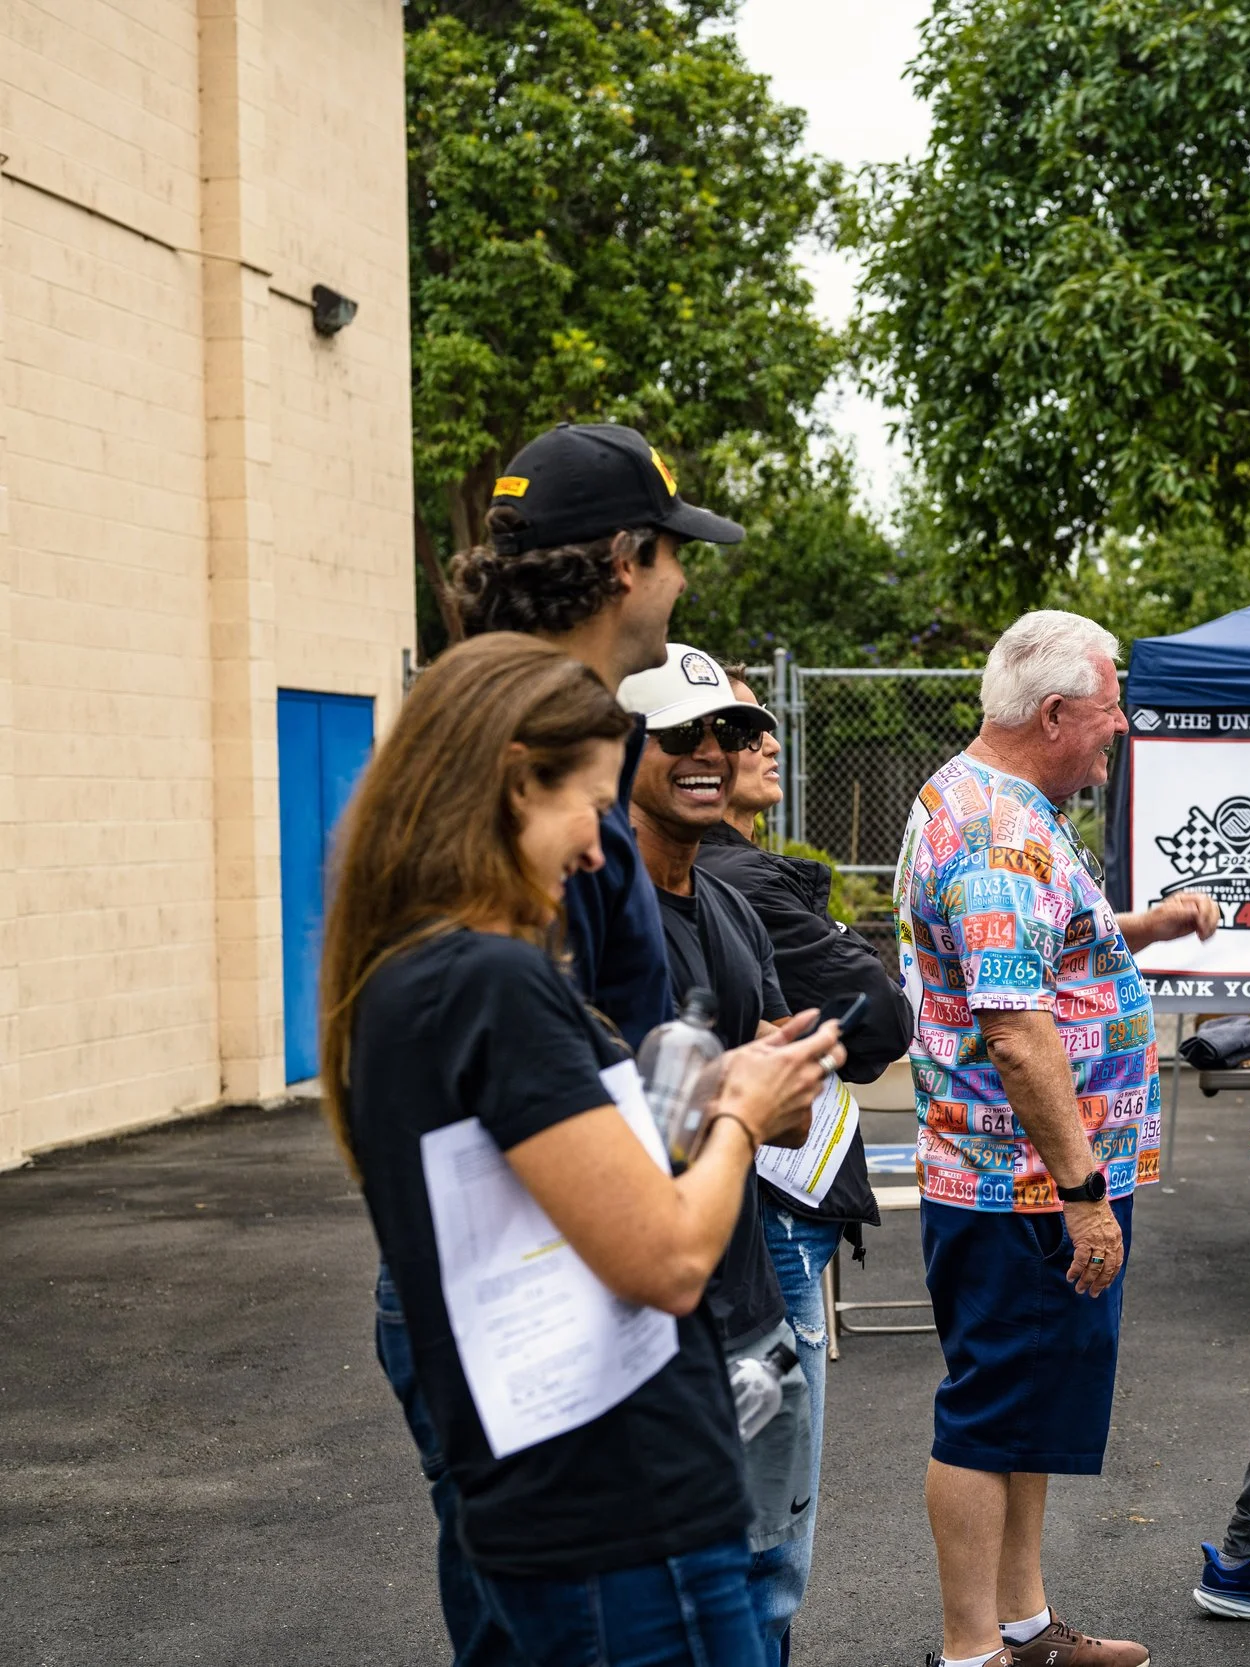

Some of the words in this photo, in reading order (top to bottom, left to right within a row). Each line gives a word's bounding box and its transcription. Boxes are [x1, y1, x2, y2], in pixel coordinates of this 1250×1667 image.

[1165, 713, 1211, 730] THE
[1213, 886, 1235, 894] BOYS
[981, 957, 1038, 980] 33765
